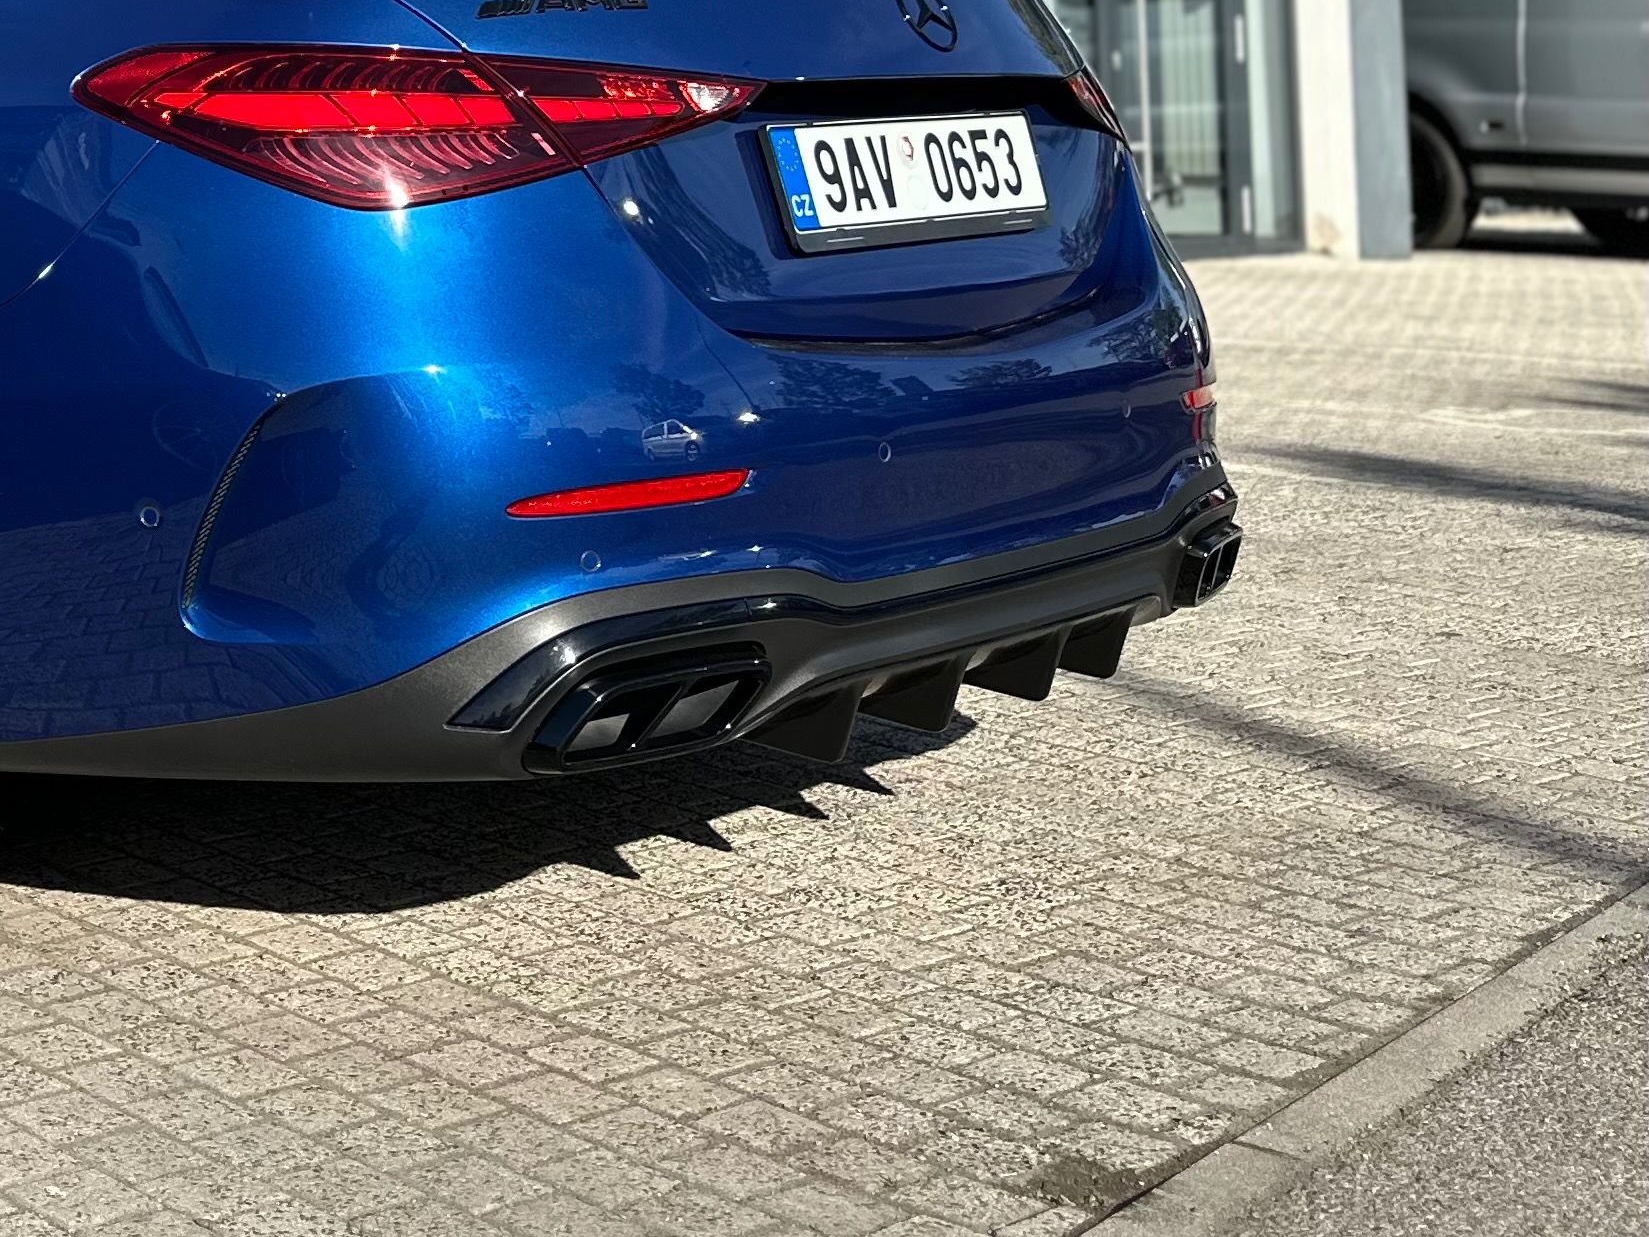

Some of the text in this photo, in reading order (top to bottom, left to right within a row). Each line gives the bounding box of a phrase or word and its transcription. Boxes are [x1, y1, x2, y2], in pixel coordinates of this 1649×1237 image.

[813, 128, 1023, 213] 9AV 0653
[791, 193, 815, 218] CZ
